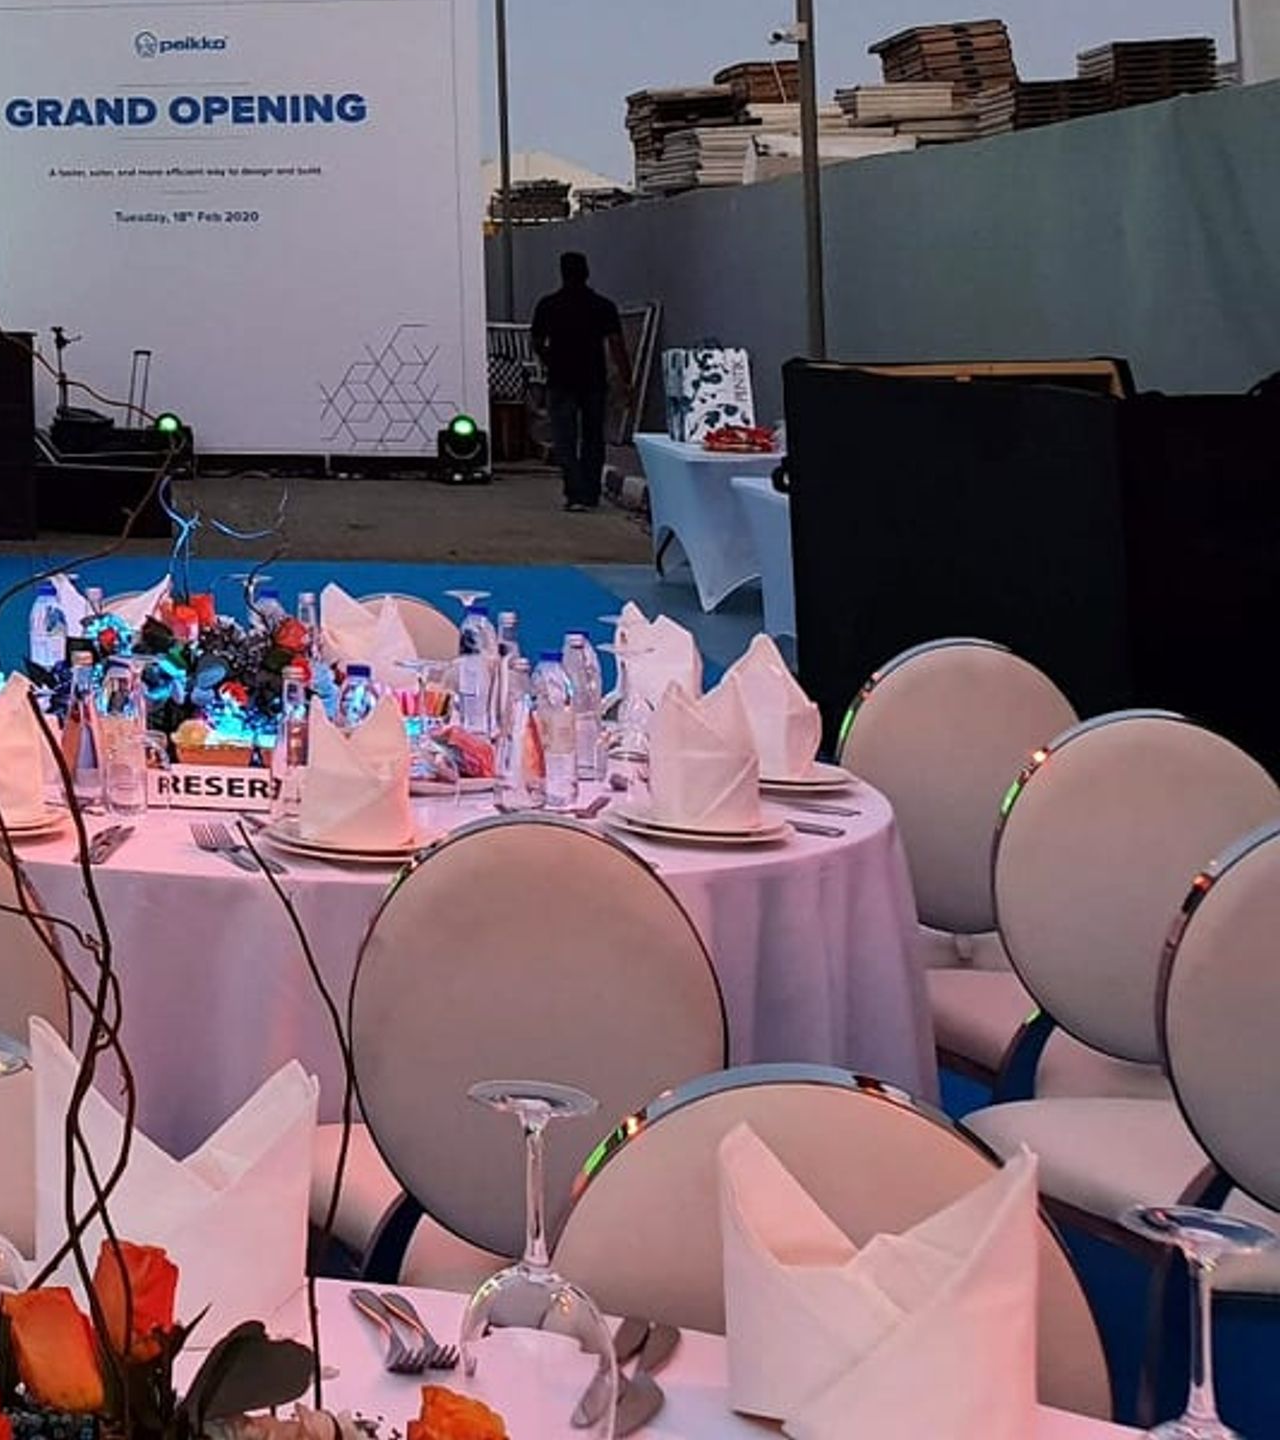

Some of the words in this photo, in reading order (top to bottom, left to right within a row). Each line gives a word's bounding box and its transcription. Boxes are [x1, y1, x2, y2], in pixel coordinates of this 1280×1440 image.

[159, 36, 226, 53] peikko
[5, 96, 157, 127] GRAND
[168, 93, 367, 124] OPENING
[224, 211, 259, 223] 2020
[157, 775, 282, 801] RESER
